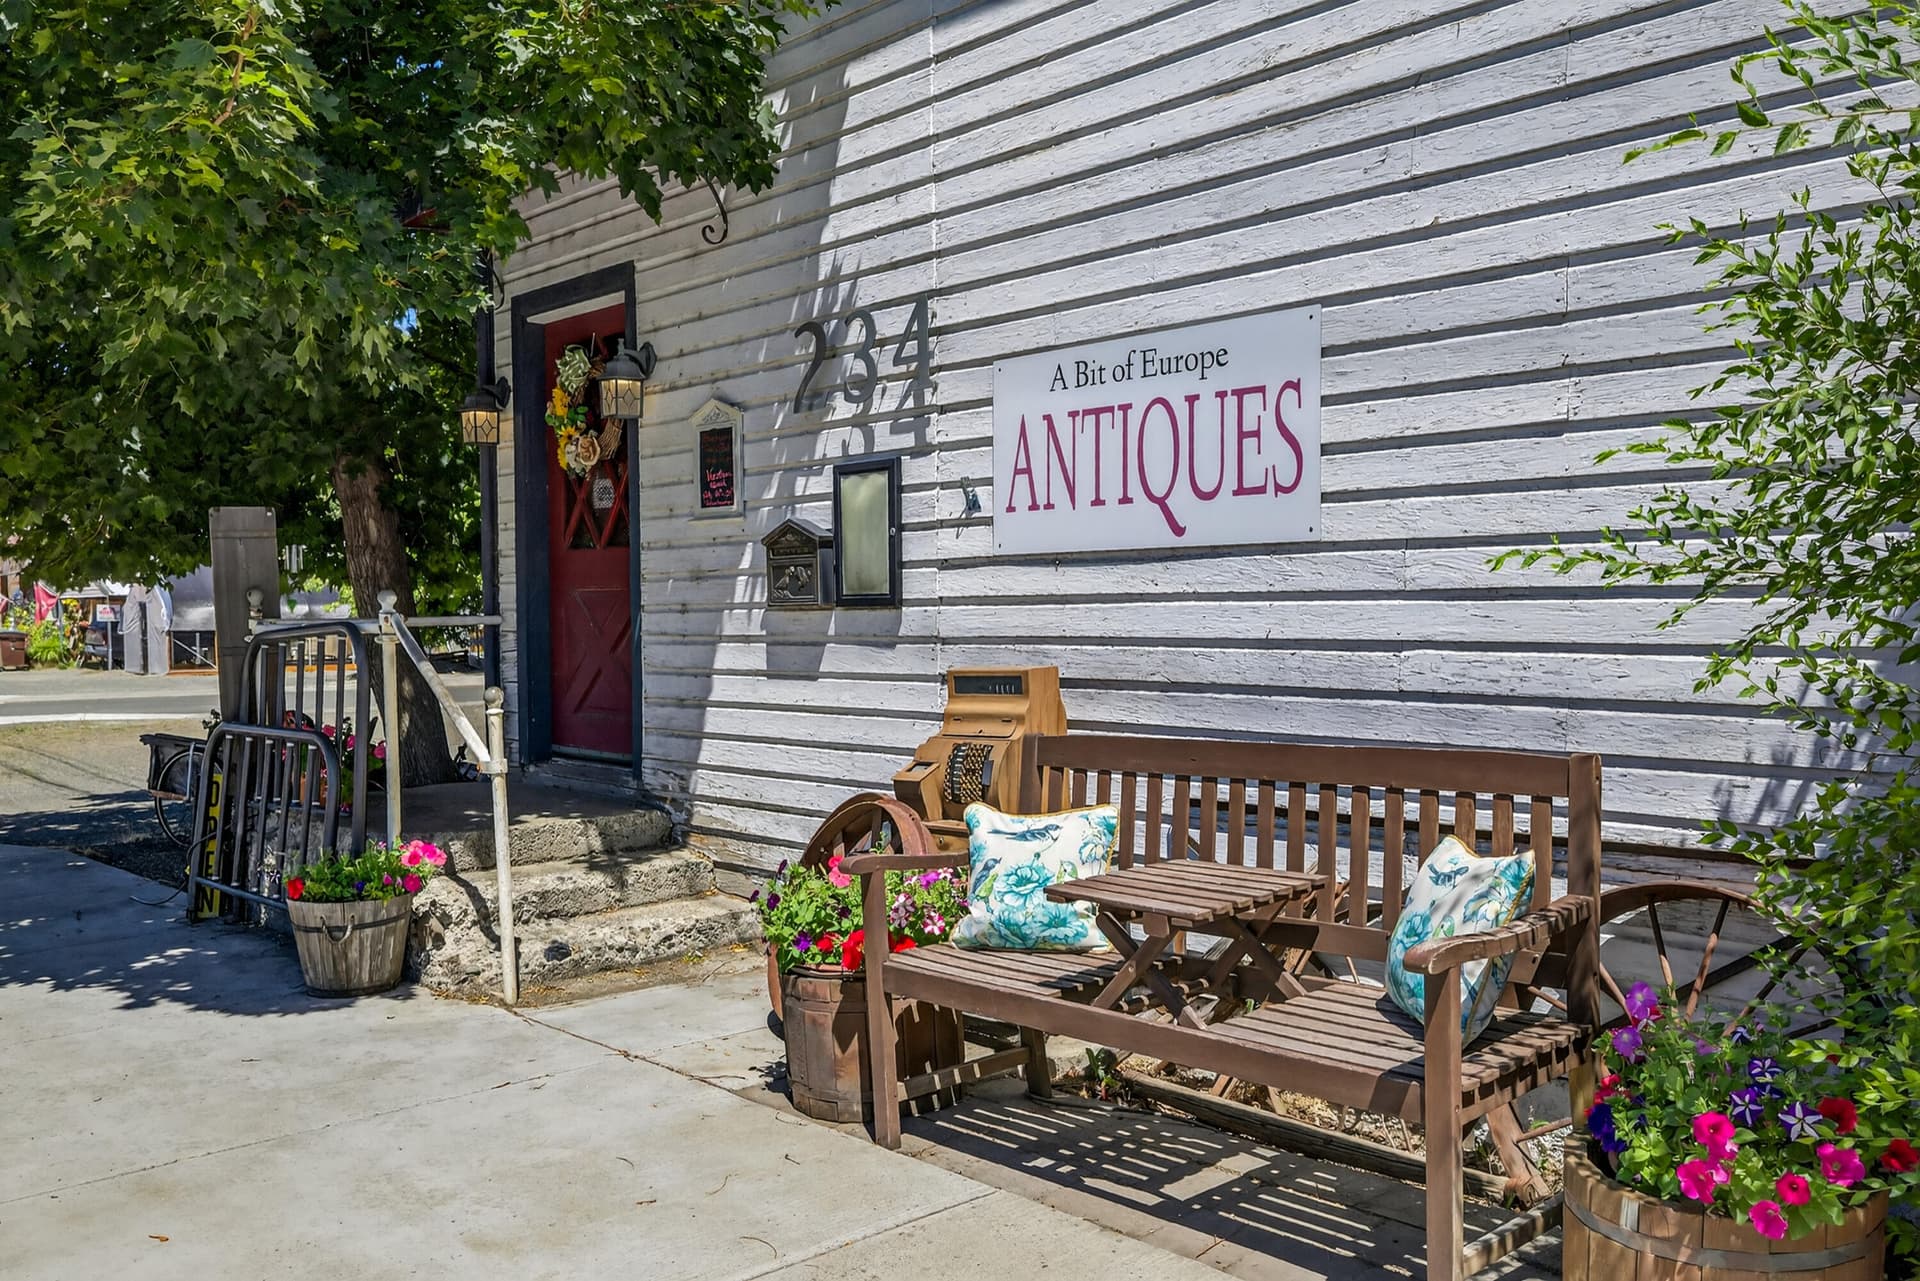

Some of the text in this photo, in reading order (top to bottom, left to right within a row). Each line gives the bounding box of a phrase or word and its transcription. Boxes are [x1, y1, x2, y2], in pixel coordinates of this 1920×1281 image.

[794, 294, 932, 413] 234
[1049, 347, 1229, 391] A Bit of Europe
[1005, 378, 1304, 537] ANTIQUES
